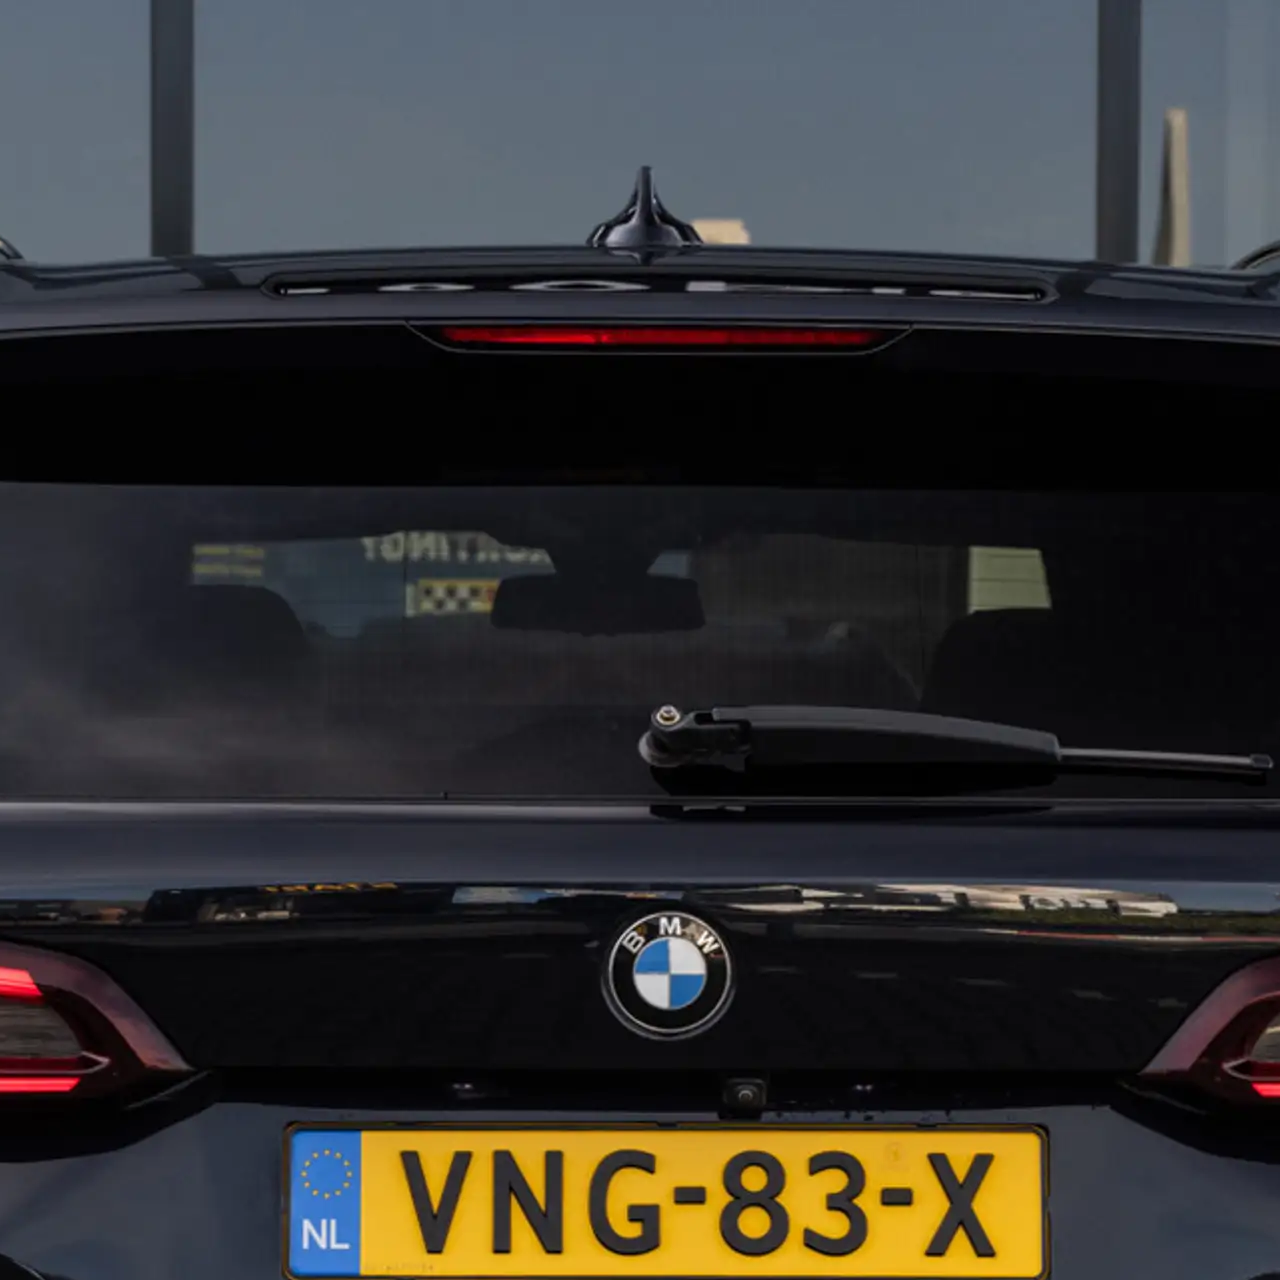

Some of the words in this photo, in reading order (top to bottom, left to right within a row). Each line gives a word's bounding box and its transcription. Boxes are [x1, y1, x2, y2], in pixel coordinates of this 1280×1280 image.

[621, 916, 721, 955] BMW
[400, 1148, 997, 1258] VNG-83-X
[301, 1217, 351, 1250] NL
